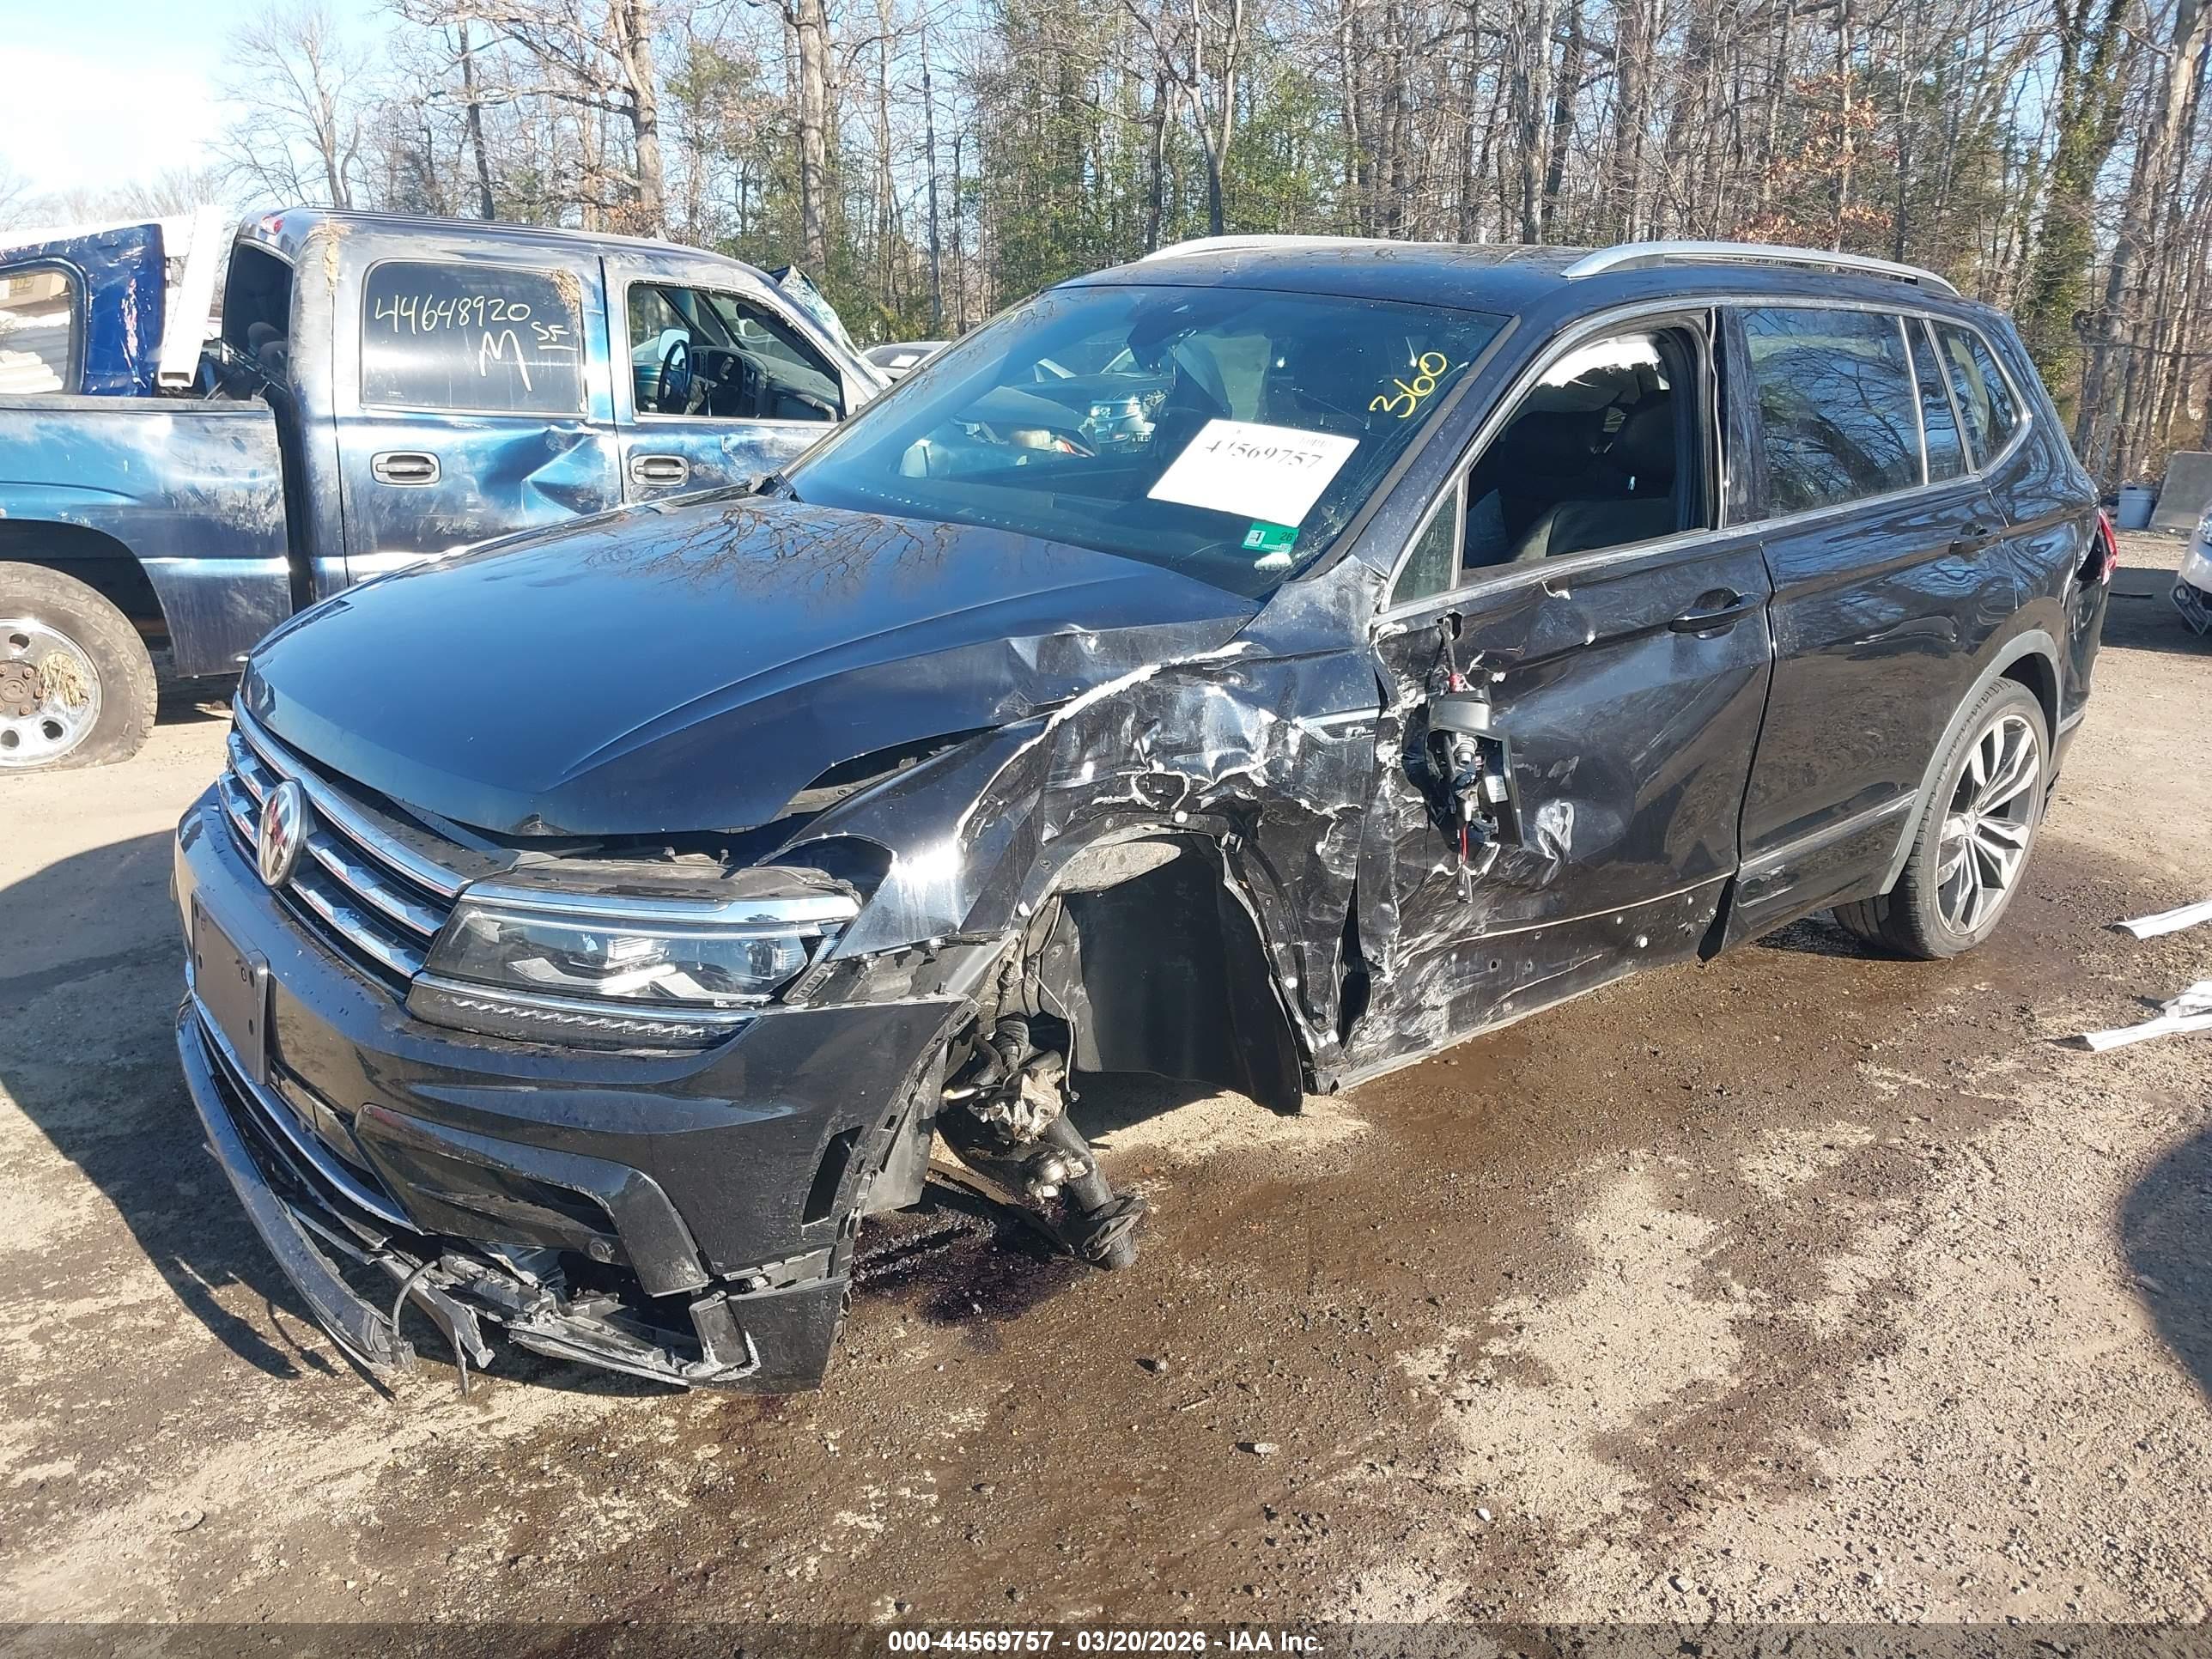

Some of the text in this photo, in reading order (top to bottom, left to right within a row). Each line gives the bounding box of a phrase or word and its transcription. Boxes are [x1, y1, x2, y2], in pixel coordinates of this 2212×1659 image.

[374, 295, 531, 335] 44648920
[478, 329, 532, 392] M
[1368, 351, 1448, 418] 360
[1279, 532, 1294, 543] 26
